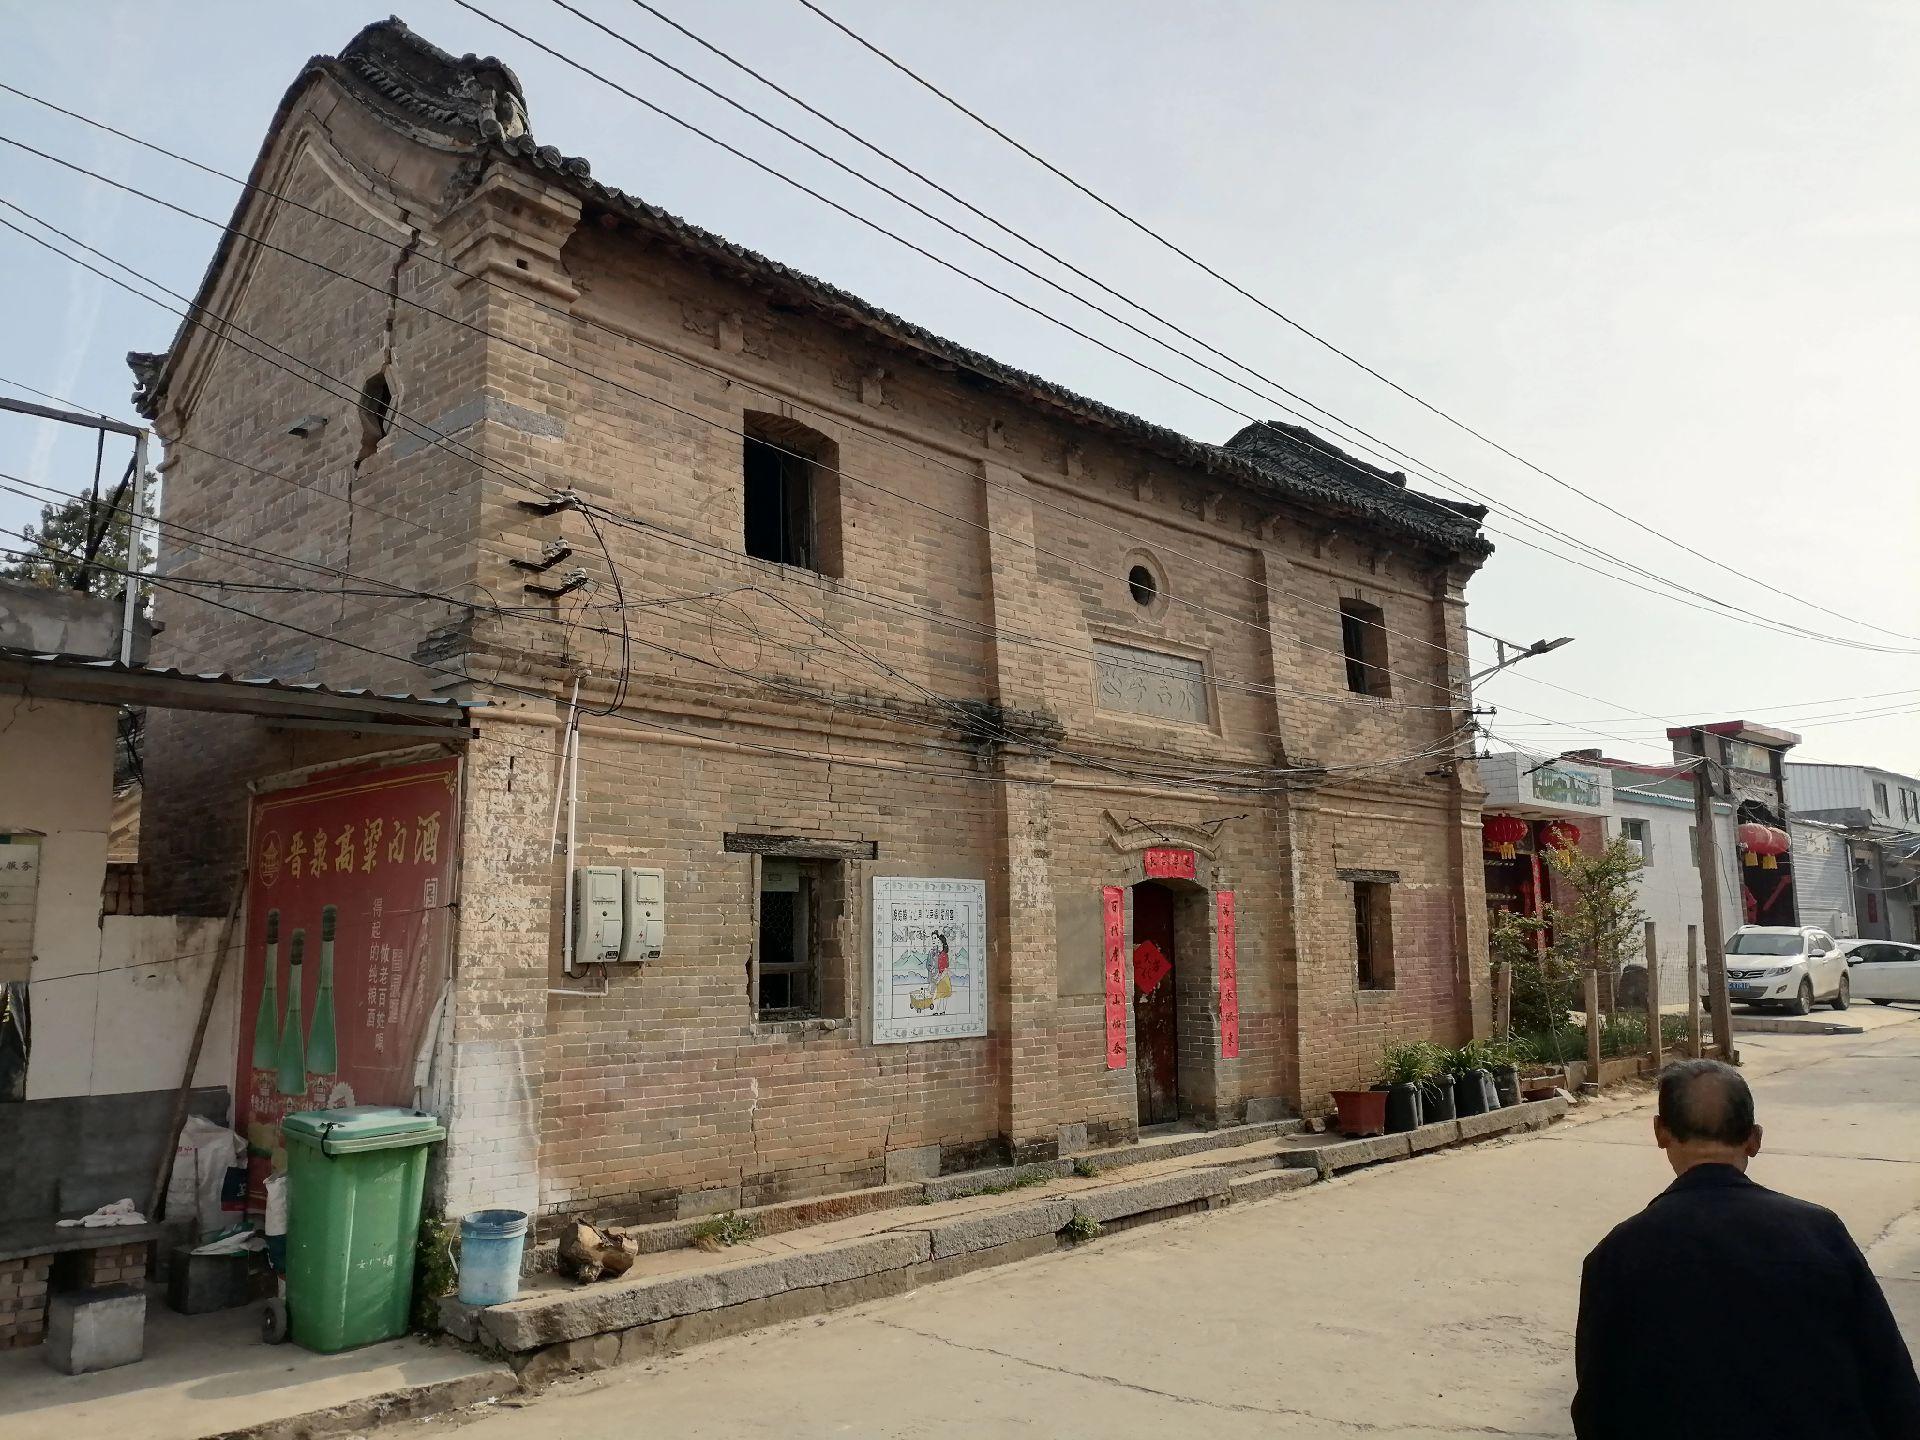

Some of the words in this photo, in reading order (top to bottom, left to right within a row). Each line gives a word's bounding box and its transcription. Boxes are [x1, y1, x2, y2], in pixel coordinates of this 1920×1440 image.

[285, 811, 441, 879] 晋泉高粱白酒
[0, 861, 33, 872] 服务
